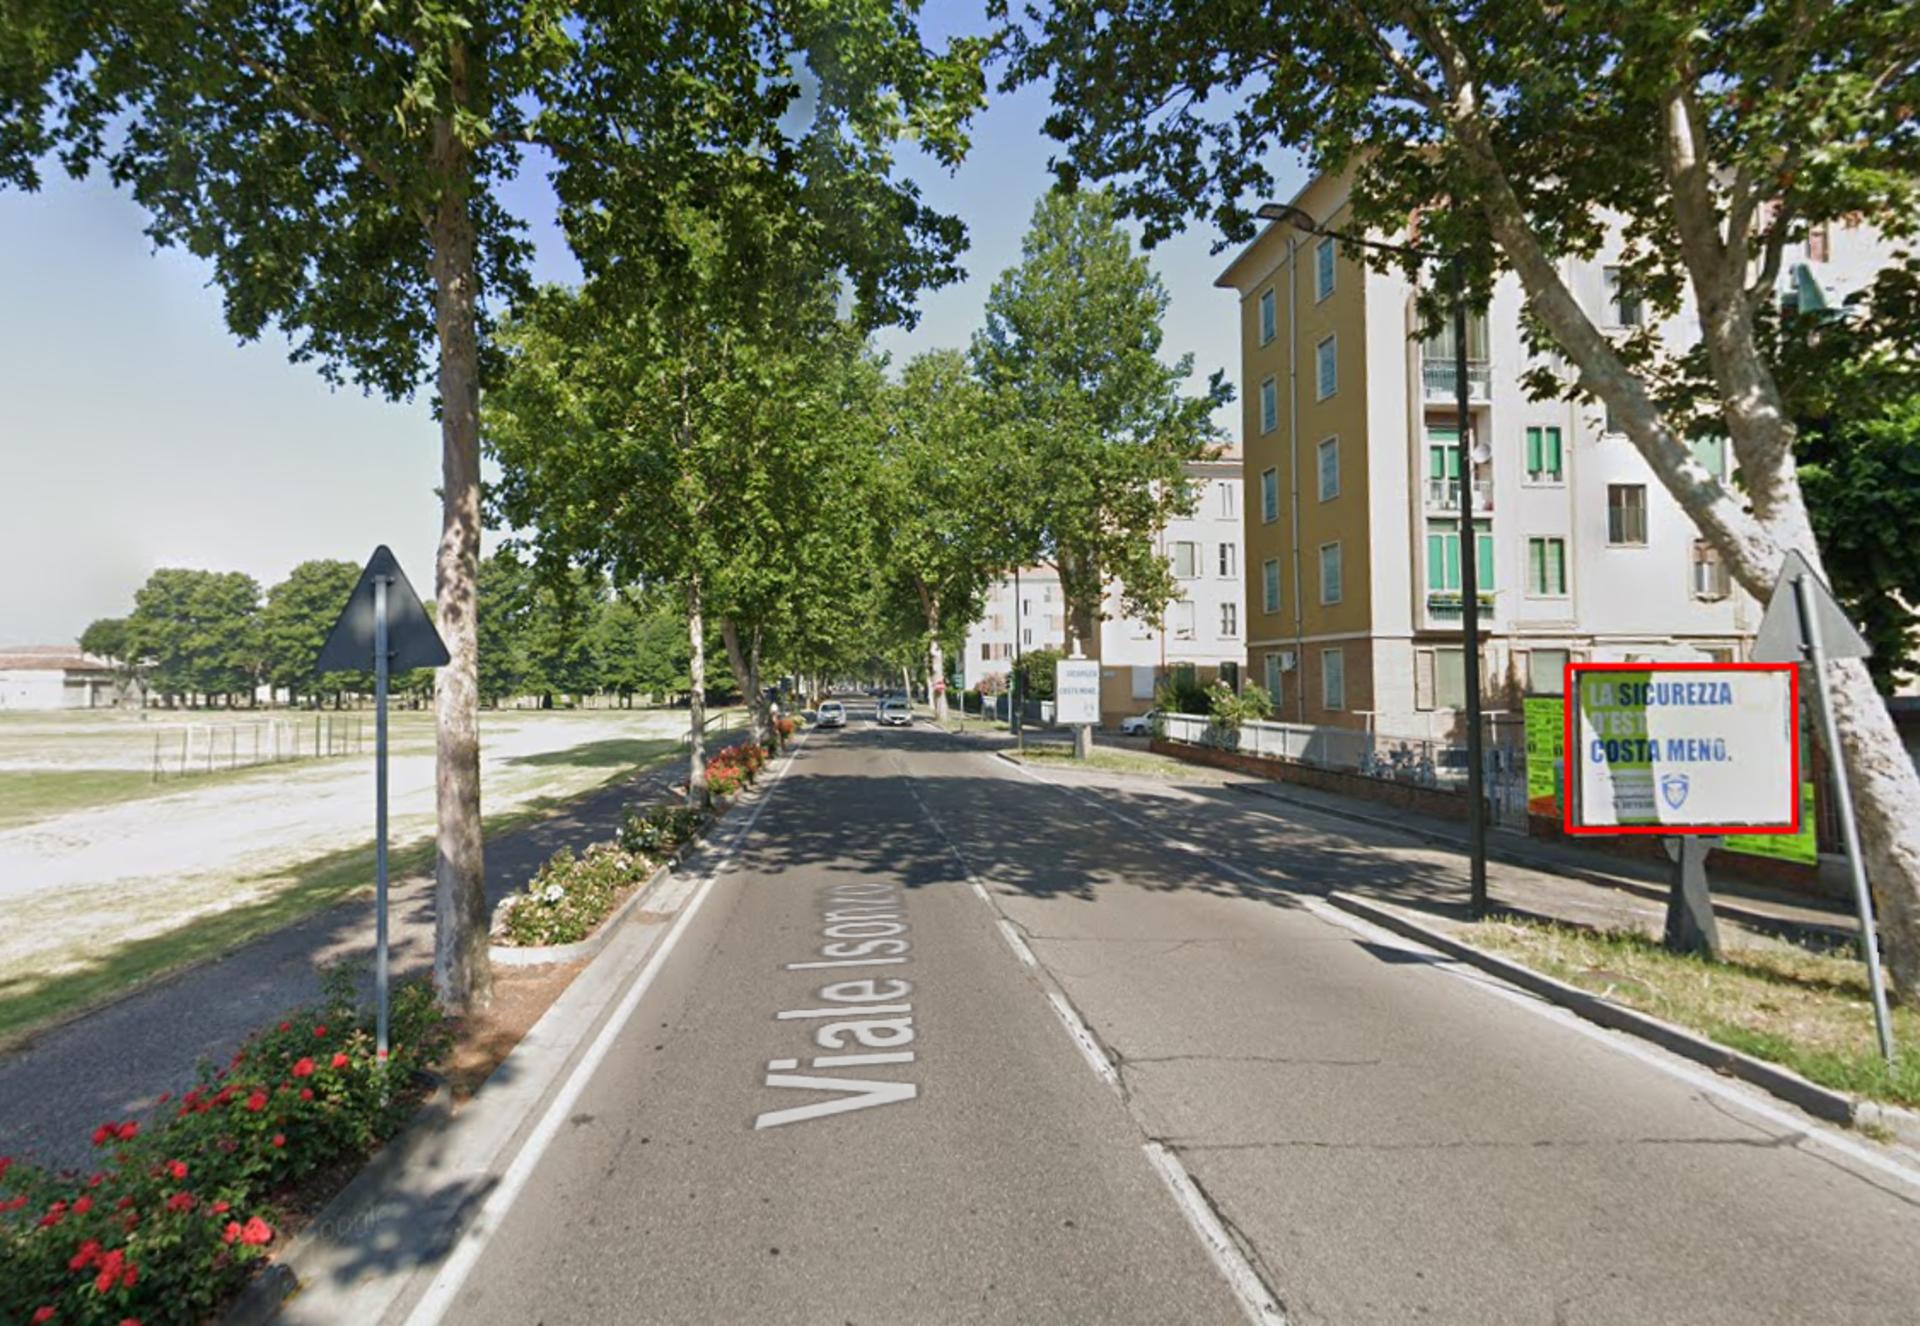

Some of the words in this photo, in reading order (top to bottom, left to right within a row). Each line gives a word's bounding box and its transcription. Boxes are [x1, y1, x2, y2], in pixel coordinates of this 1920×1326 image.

[1590, 683, 1615, 706] LA
[1618, 682, 1732, 706] SICUREZZA
[1590, 738, 1660, 763] COSTA
